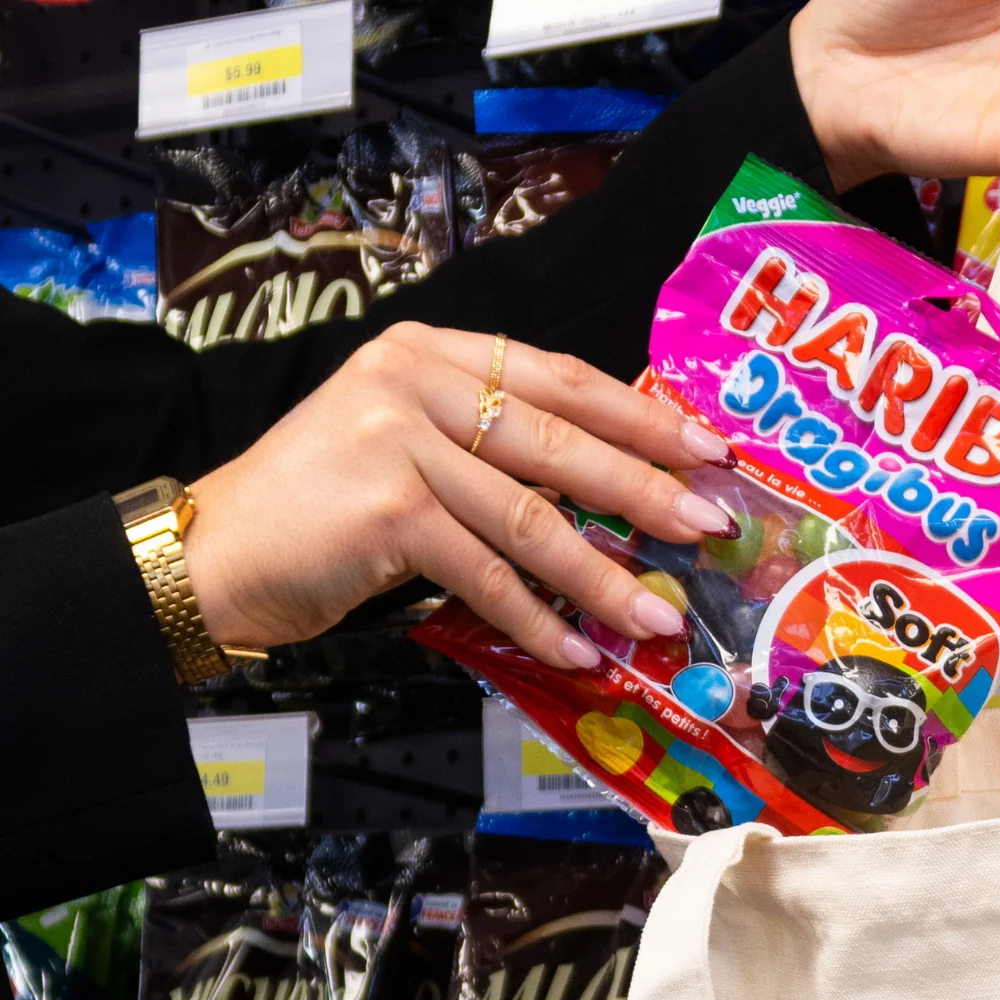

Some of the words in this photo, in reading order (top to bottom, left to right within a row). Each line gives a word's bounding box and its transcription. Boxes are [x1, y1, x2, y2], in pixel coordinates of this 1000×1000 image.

[767, 473, 782, 488] la
[785, 483, 806, 499] vie
[863, 580, 975, 681] Soft
[623, 680, 640, 694] et
[641, 688, 662, 710] les
[660, 707, 701, 738] petits
